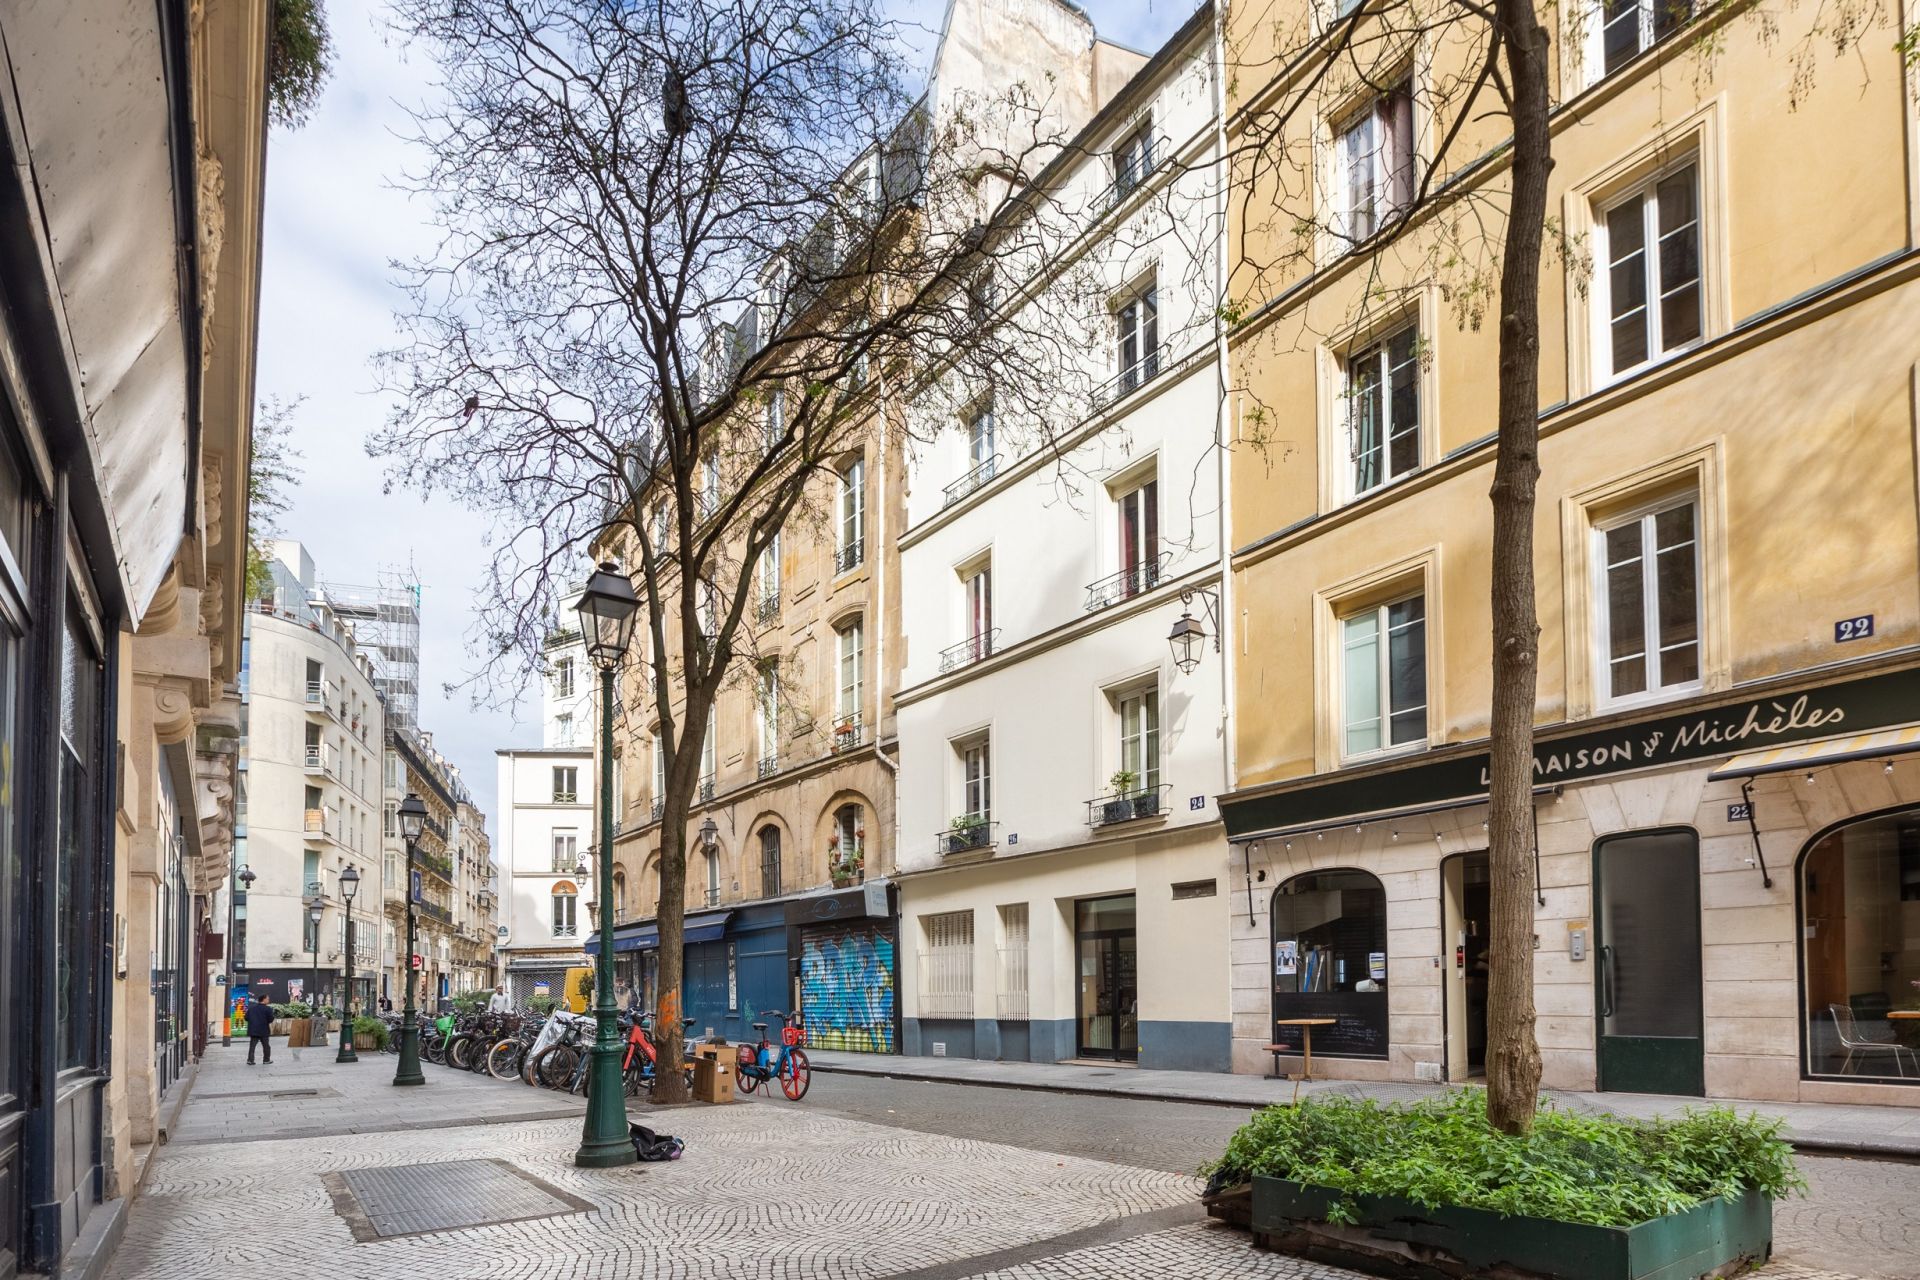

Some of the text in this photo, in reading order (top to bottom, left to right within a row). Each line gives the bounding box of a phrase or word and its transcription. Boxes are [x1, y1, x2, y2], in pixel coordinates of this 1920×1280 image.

[1840, 618, 1869, 640] 22
[1670, 694, 1845, 753] Michèles
[1191, 796, 1204, 810] 24
[1731, 805, 1750, 819] 22
